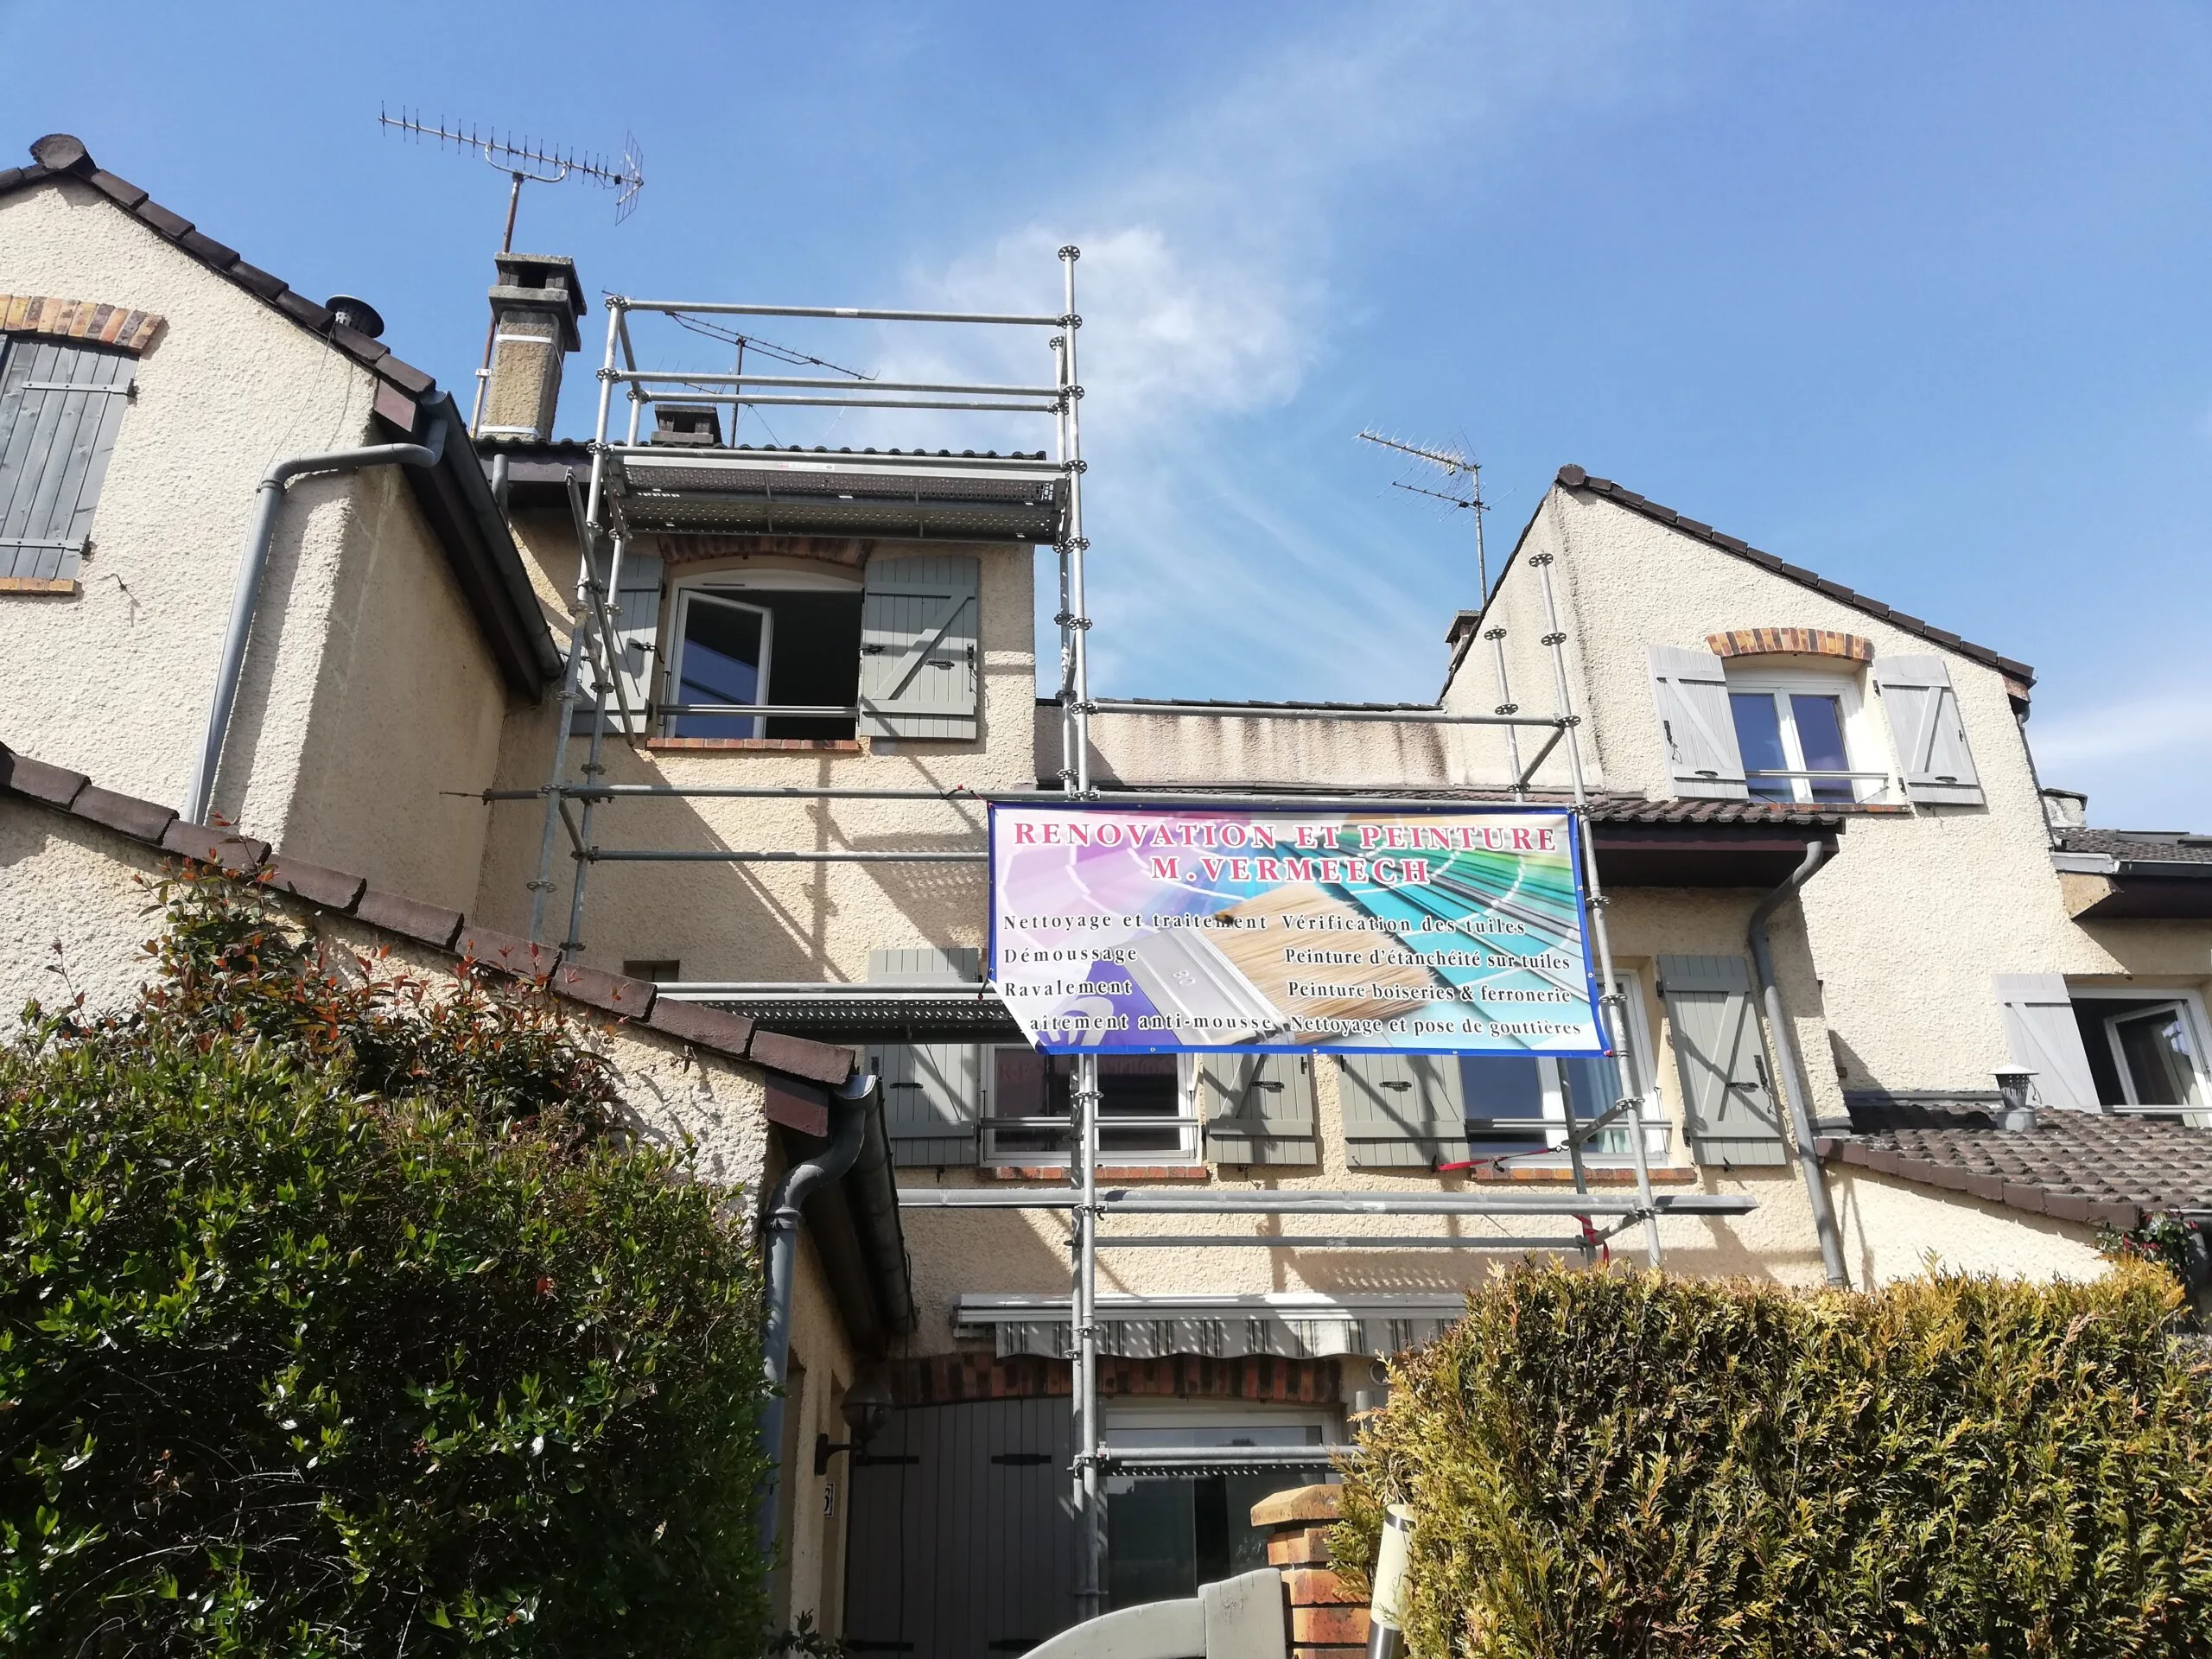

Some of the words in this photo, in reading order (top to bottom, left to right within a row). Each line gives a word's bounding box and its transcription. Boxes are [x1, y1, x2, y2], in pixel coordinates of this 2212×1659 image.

[1014, 823, 1275, 848] RENOVATION
[1296, 825, 1339, 849] ET
[1360, 826, 1557, 851] PEINTURE
[1152, 857, 1430, 883] M.VERMEECH
[1004, 914, 1112, 931] Nettoyage
[1123, 914, 1141, 927] et
[1282, 914, 1410, 931] Vérification
[1422, 917, 1456, 932] des
[1466, 918, 1525, 934] tuiles
[1004, 947, 1137, 964] Démoussage
[1285, 949, 1362, 964] Peinture
[1488, 956, 1516, 968] sur
[1522, 954, 1570, 969] tuiles
[1005, 979, 1133, 996] Ravalement
[1288, 982, 1365, 998] Peinture
[1373, 984, 1453, 1001] boiseries
[1461, 987, 1473, 1001] &
[1481, 986, 1571, 1002] ferronerie
[1139, 1014, 1272, 1030] anti-mousse
[1292, 1016, 1382, 1034] Nettoyage
[1389, 1019, 1407, 1033] et
[1414, 1022, 1454, 1037] pose
[1461, 1019, 1482, 1034] de
[1491, 1020, 1580, 1039] gouttières
